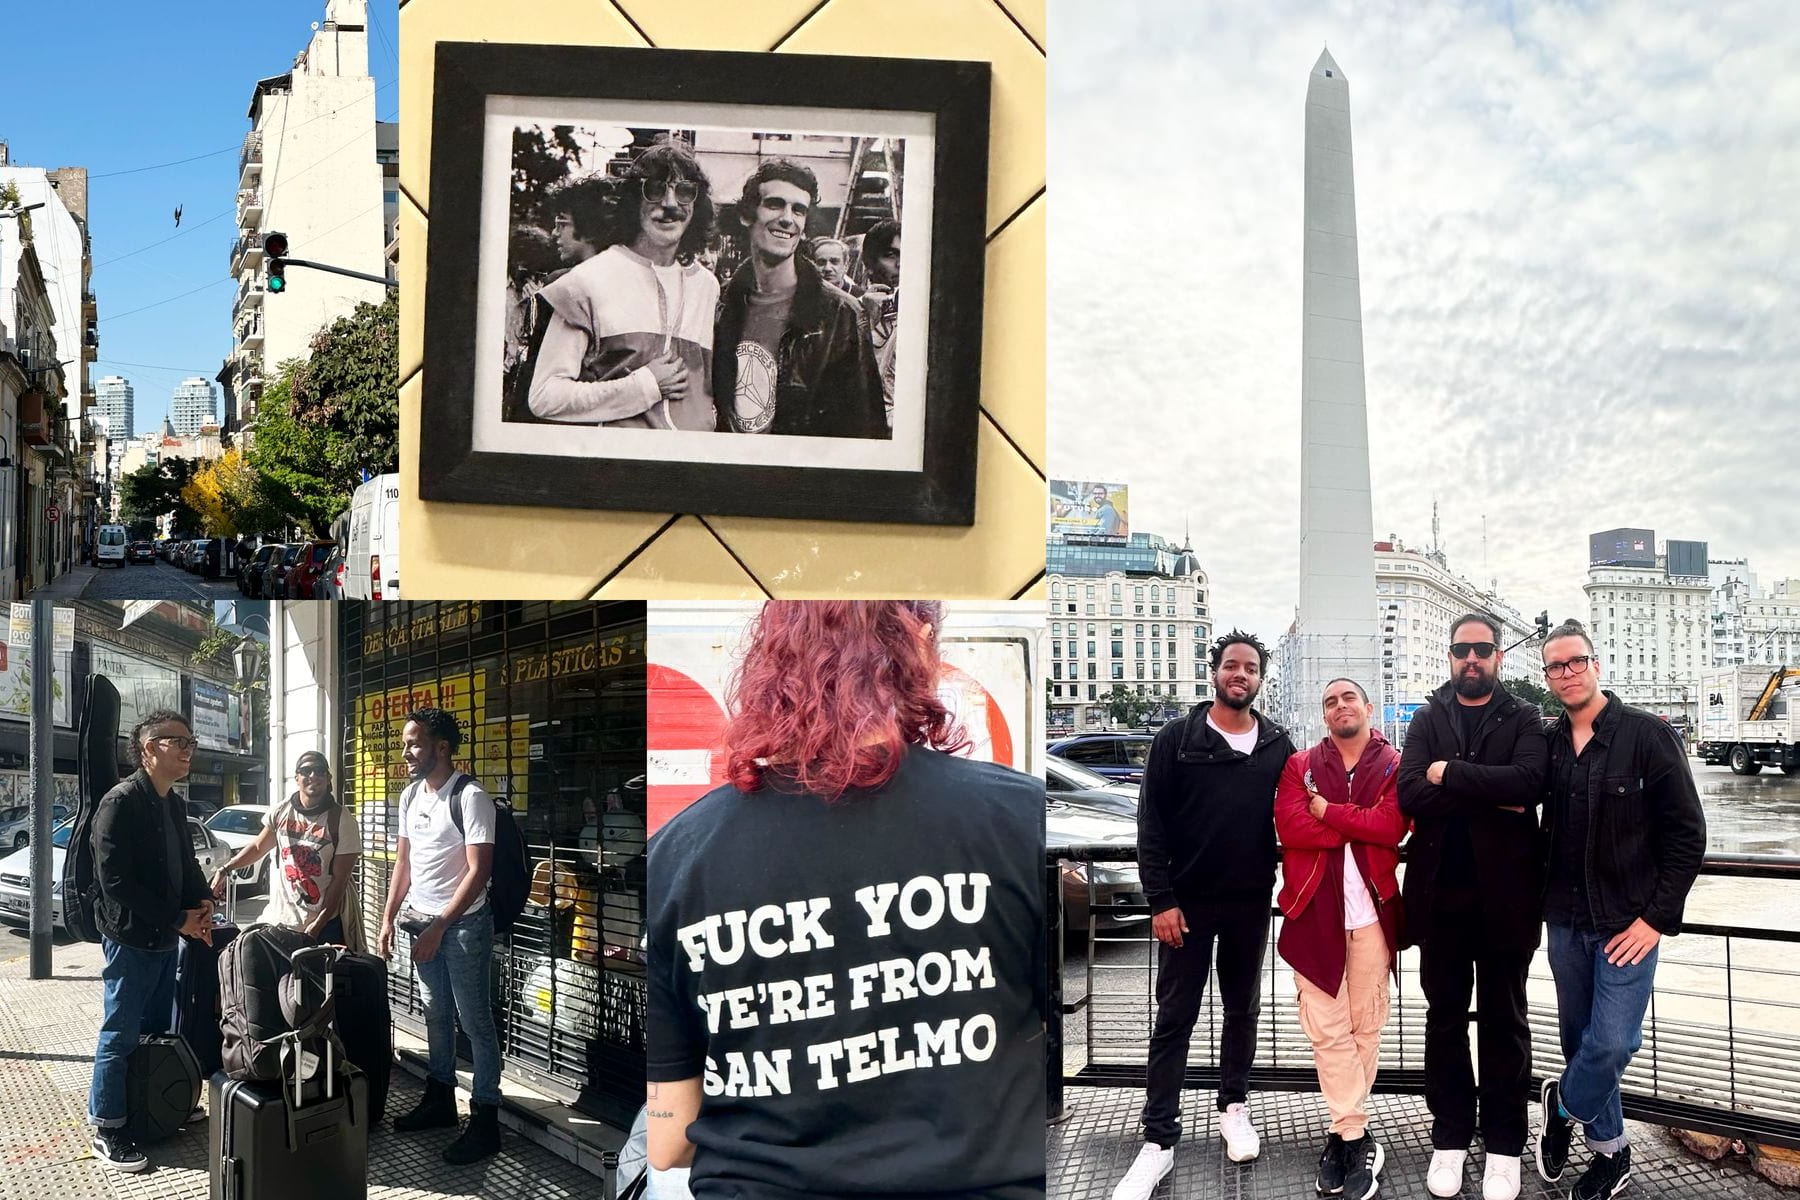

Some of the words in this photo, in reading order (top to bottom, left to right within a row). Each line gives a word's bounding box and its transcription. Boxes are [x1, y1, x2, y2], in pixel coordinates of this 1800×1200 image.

[736, 344, 775, 369] ERCEDES
[1710, 693, 1724, 706] BA
[371, 720, 392, 732] PAPL
[373, 741, 401, 751] ROLOS
[676, 896, 835, 973] FUCK
[855, 872, 992, 938] YOU
[848, 946, 996, 1011] FROM
[703, 1048, 792, 1097] SAN
[807, 1013, 998, 1091] TELMO
